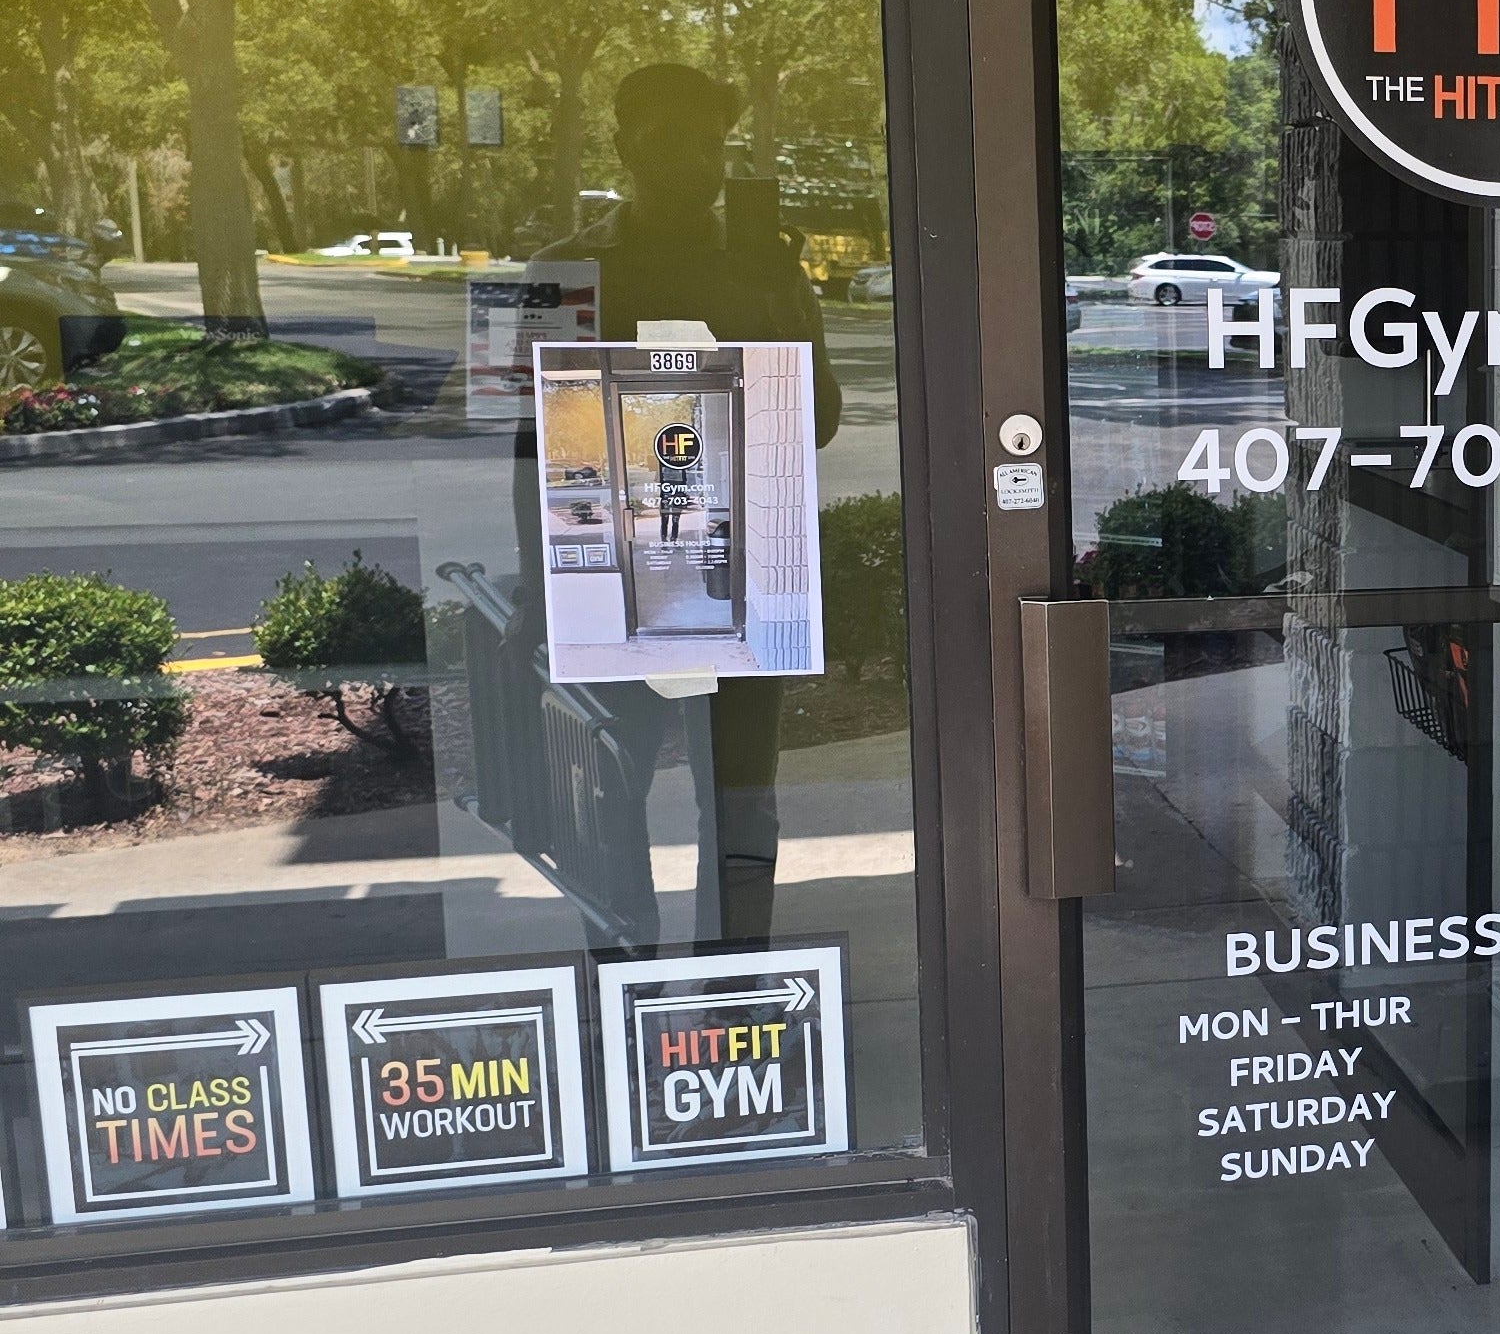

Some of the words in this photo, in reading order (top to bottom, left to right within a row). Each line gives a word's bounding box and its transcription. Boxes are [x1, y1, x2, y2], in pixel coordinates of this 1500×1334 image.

[1366, 75, 1425, 103] THE
[652, 353, 695, 370] 3869
[662, 433, 695, 455] HF
[644, 482, 715, 495] HFGym.com
[1178, 1007, 1269, 1043] MON
[1312, 996, 1411, 1030] THUR
[661, 1023, 787, 1067] HITFIT
[381, 1058, 445, 1107] 35
[451, 1058, 530, 1100] MIN
[1230, 1047, 1362, 1087] FRIDAY
[92, 1086, 136, 1116] NO
[146, 1076, 251, 1112] CLASS
[663, 1063, 783, 1122] GYM
[380, 1100, 535, 1140] WORKOUT
[1198, 1091, 1396, 1136] SATURDAY
[96, 1109, 257, 1164] TIMES
[1220, 1139, 1375, 1182] SUNDAY
